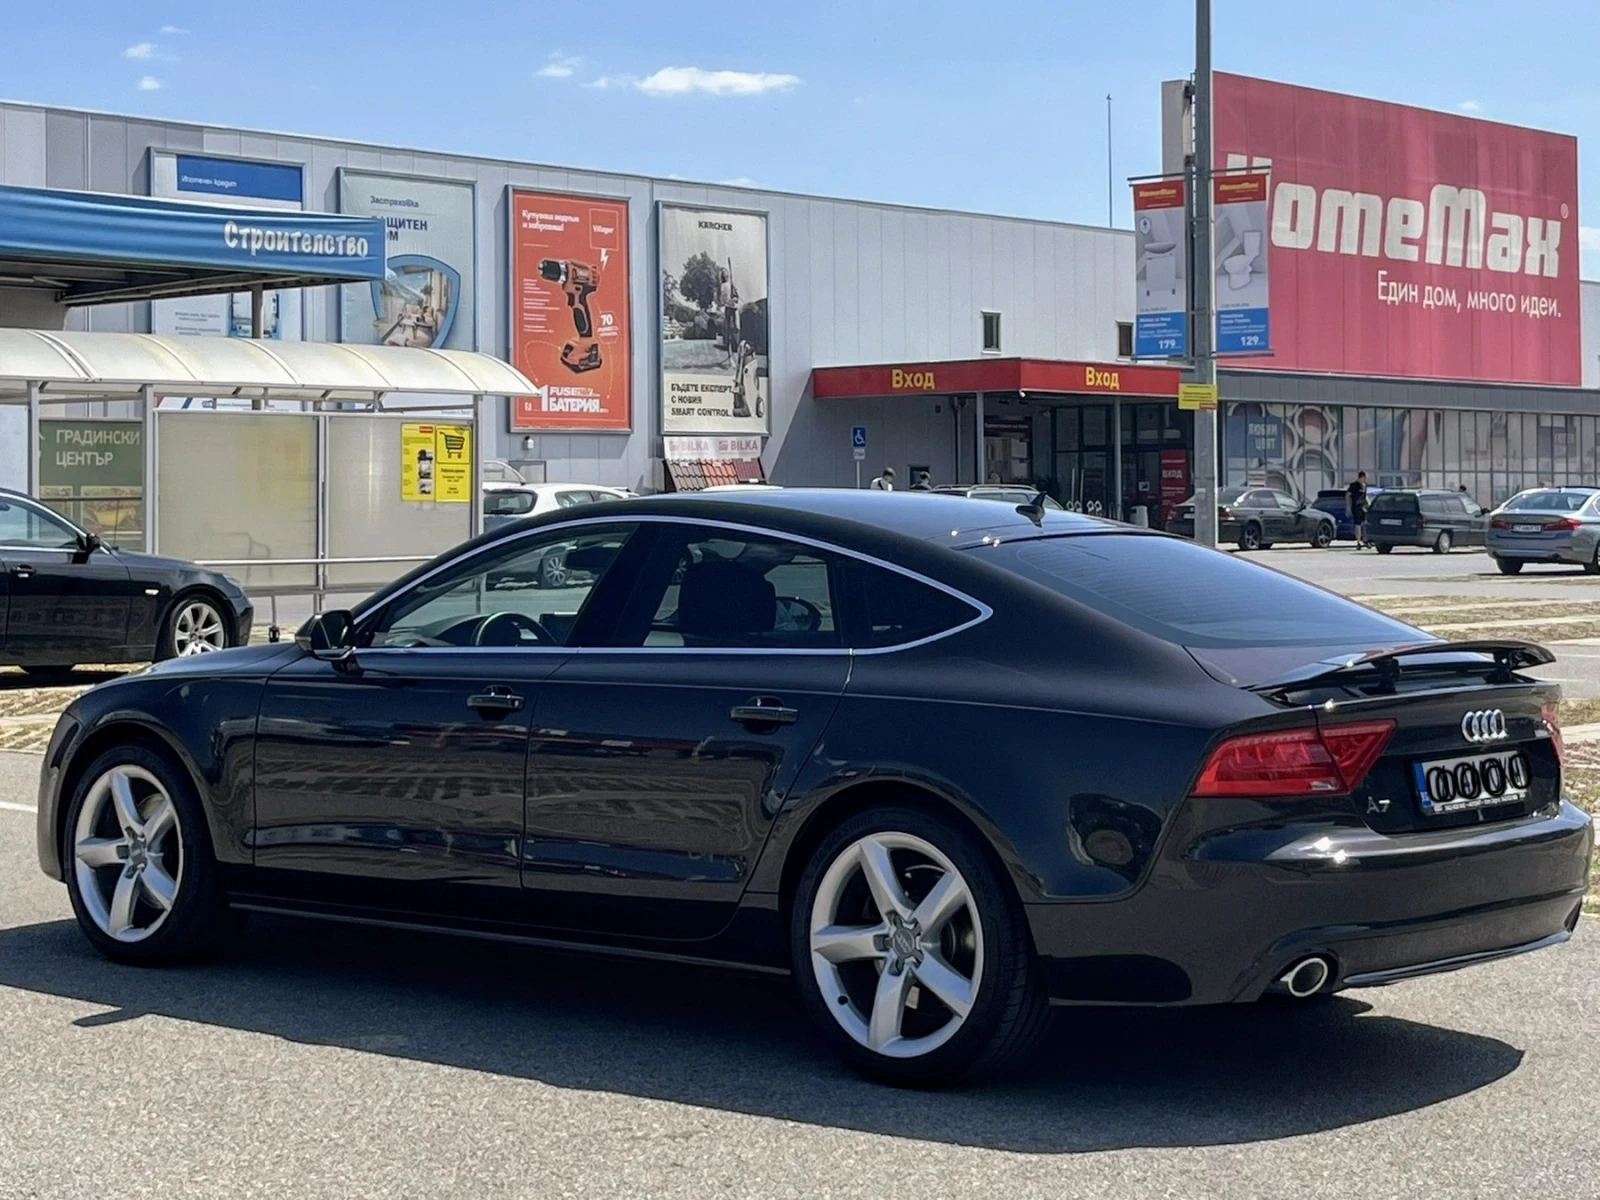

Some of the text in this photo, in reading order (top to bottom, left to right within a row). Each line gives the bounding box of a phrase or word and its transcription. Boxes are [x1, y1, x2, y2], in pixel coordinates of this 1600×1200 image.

[370, 195, 420, 208] Застраховка
[371, 216, 428, 231] ЩИТЕН
[224, 221, 369, 257] Строителство
[1377, 270, 1562, 318] Един дом, много идеи.
[600, 314, 614, 326] 70
[1158, 339, 1177, 350] 179
[1240, 335, 1260, 346] 129
[891, 368, 935, 391] Вход
[1085, 366, 1120, 389] Вход
[549, 397, 601, 413] БАТЕРИЯ
[671, 407, 695, 416] SMART
[56, 429, 141, 447] ГРАДИНСКИ
[730, 440, 758, 451] BILKA
[56, 451, 114, 468] ЦЕНТЪР
[1366, 797, 1391, 815] A7
